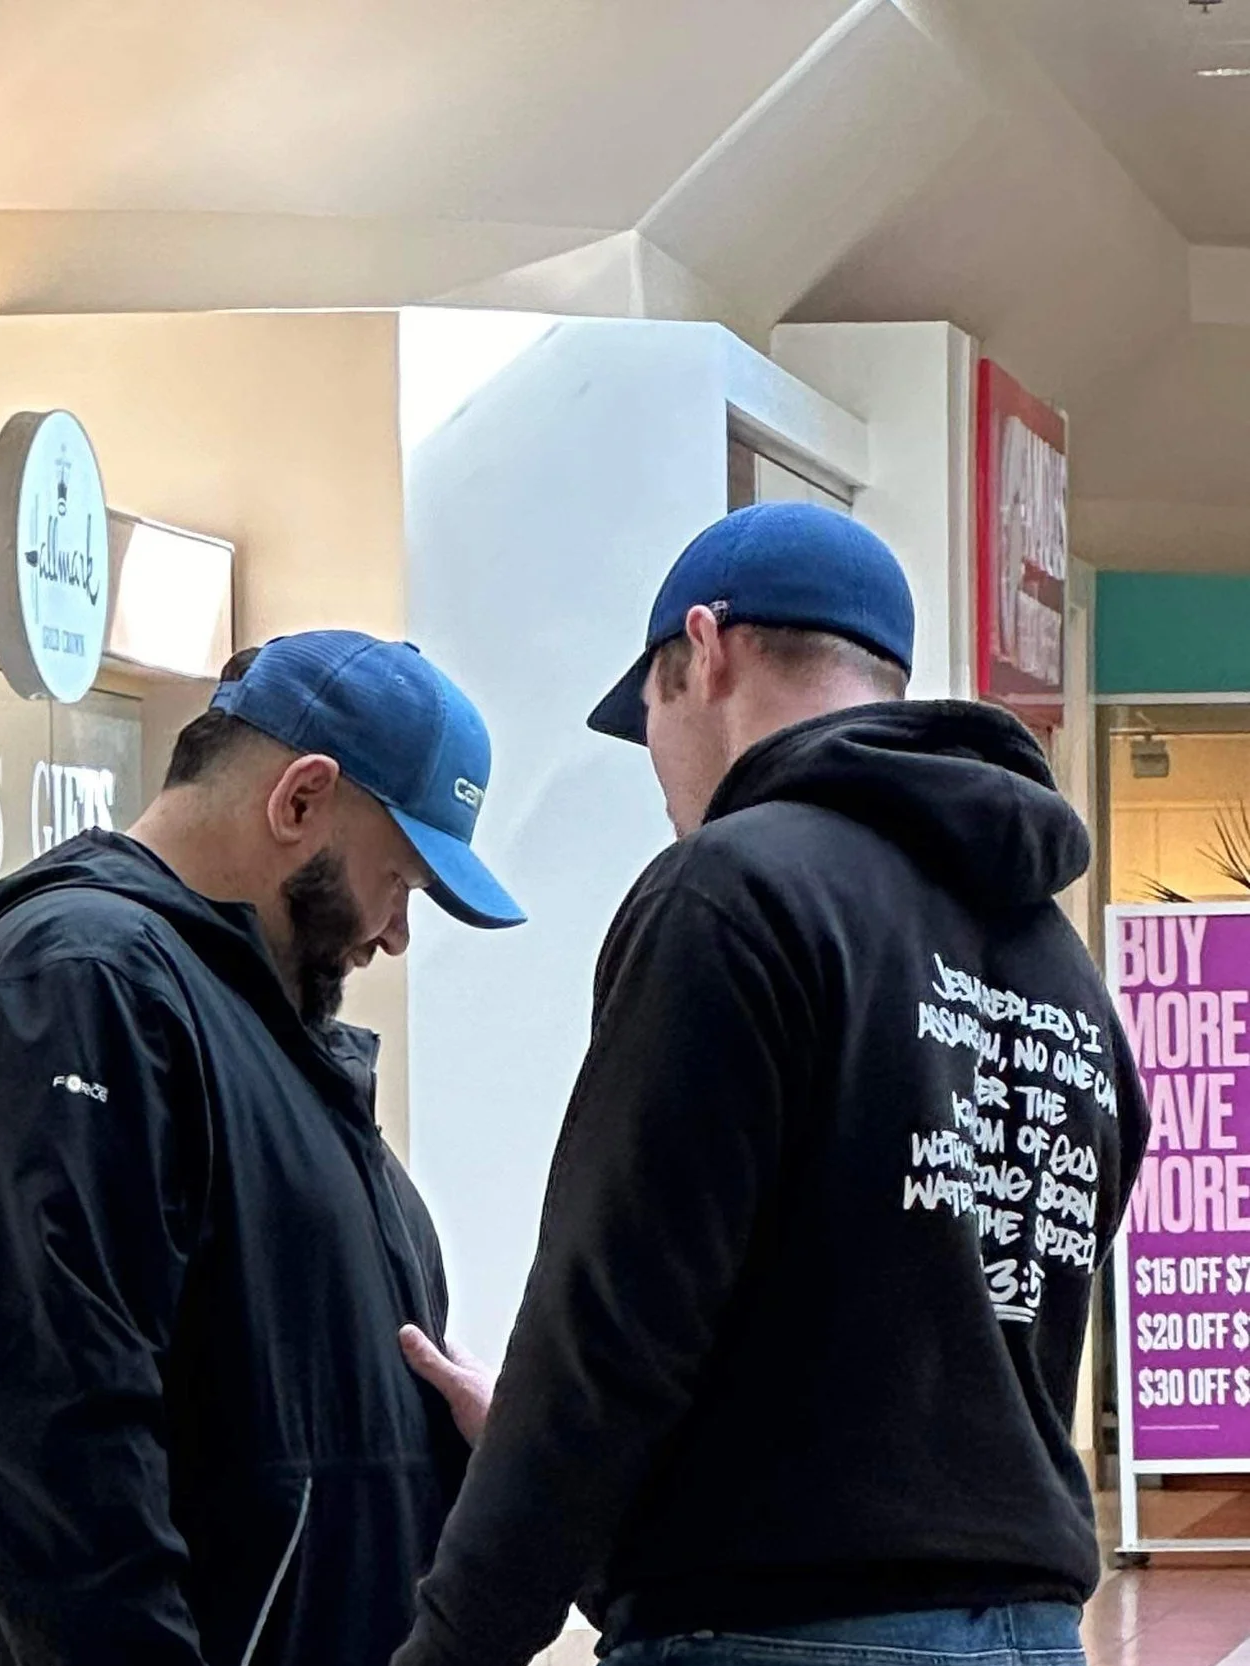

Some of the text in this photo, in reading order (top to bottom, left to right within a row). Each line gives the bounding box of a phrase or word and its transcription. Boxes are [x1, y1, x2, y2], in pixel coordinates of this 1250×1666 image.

[24, 496, 100, 622] Hallmark
[31, 760, 115, 859] GIFTS
[1119, 916, 1207, 987] BUY
[1120, 990, 1250, 1069] MORE
[1014, 1034, 1049, 1073] NO
[1052, 1052, 1096, 1091] ONE
[1013, 1085, 1067, 1126] THE
[1140, 1072, 1237, 1151] AVE
[1017, 1124, 1050, 1167] OF
[1049, 1134, 1098, 1183] GOD
[1036, 1170, 1098, 1228] BORN
[1127, 1154, 1250, 1234] MORE
[975, 1203, 1025, 1246] THE
[1135, 1255, 1177, 1298] $15
[1180, 1256, 1223, 1296] OFF
[1137, 1311, 1184, 1354] $20
[1187, 1312, 1230, 1351] OFF
[1138, 1367, 1185, 1410] $30
[1188, 1367, 1231, 1406] OFF
